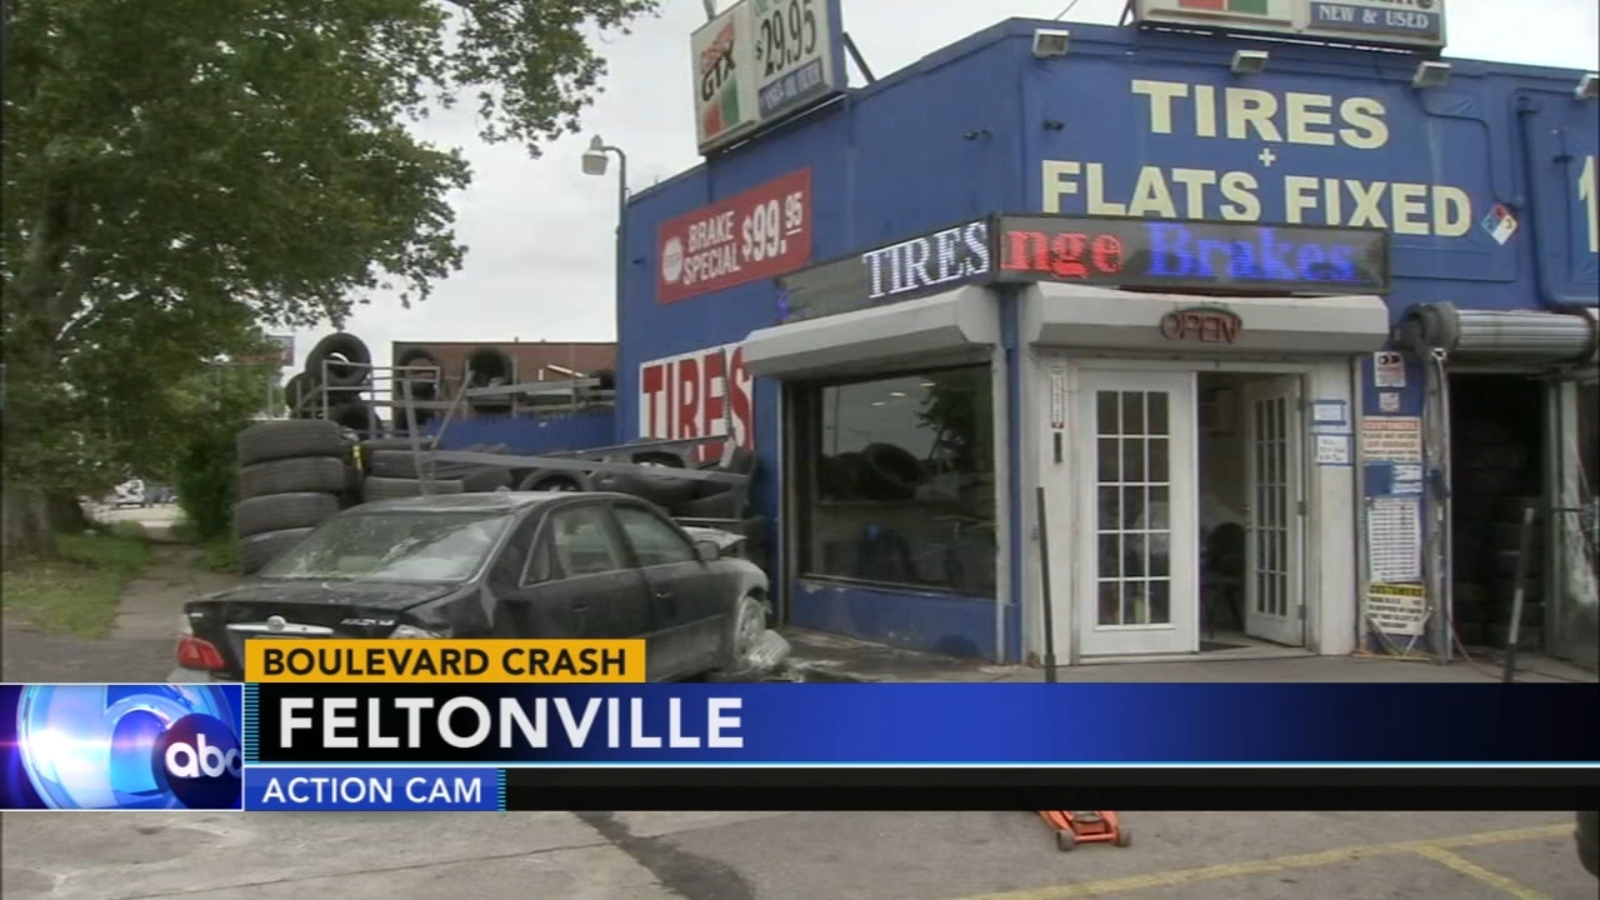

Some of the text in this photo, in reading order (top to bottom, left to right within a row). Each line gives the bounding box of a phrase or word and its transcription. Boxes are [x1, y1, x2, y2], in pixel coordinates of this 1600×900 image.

[756, 0, 816, 77] $29.95
[1318, 5, 1429, 29] NEW & USED
[702, 40, 735, 101] GTX
[1131, 79, 1389, 149] TIRES
[1041, 159, 1472, 237] FLATS FIXED
[688, 210, 735, 253] BRAKE
[862, 220, 991, 299] TIRES
[1145, 222, 1357, 282] Brakes
[683, 241, 741, 286] SPECIAL
[1161, 309, 1242, 344] OPEN
[642, 346, 753, 451] TIRES
